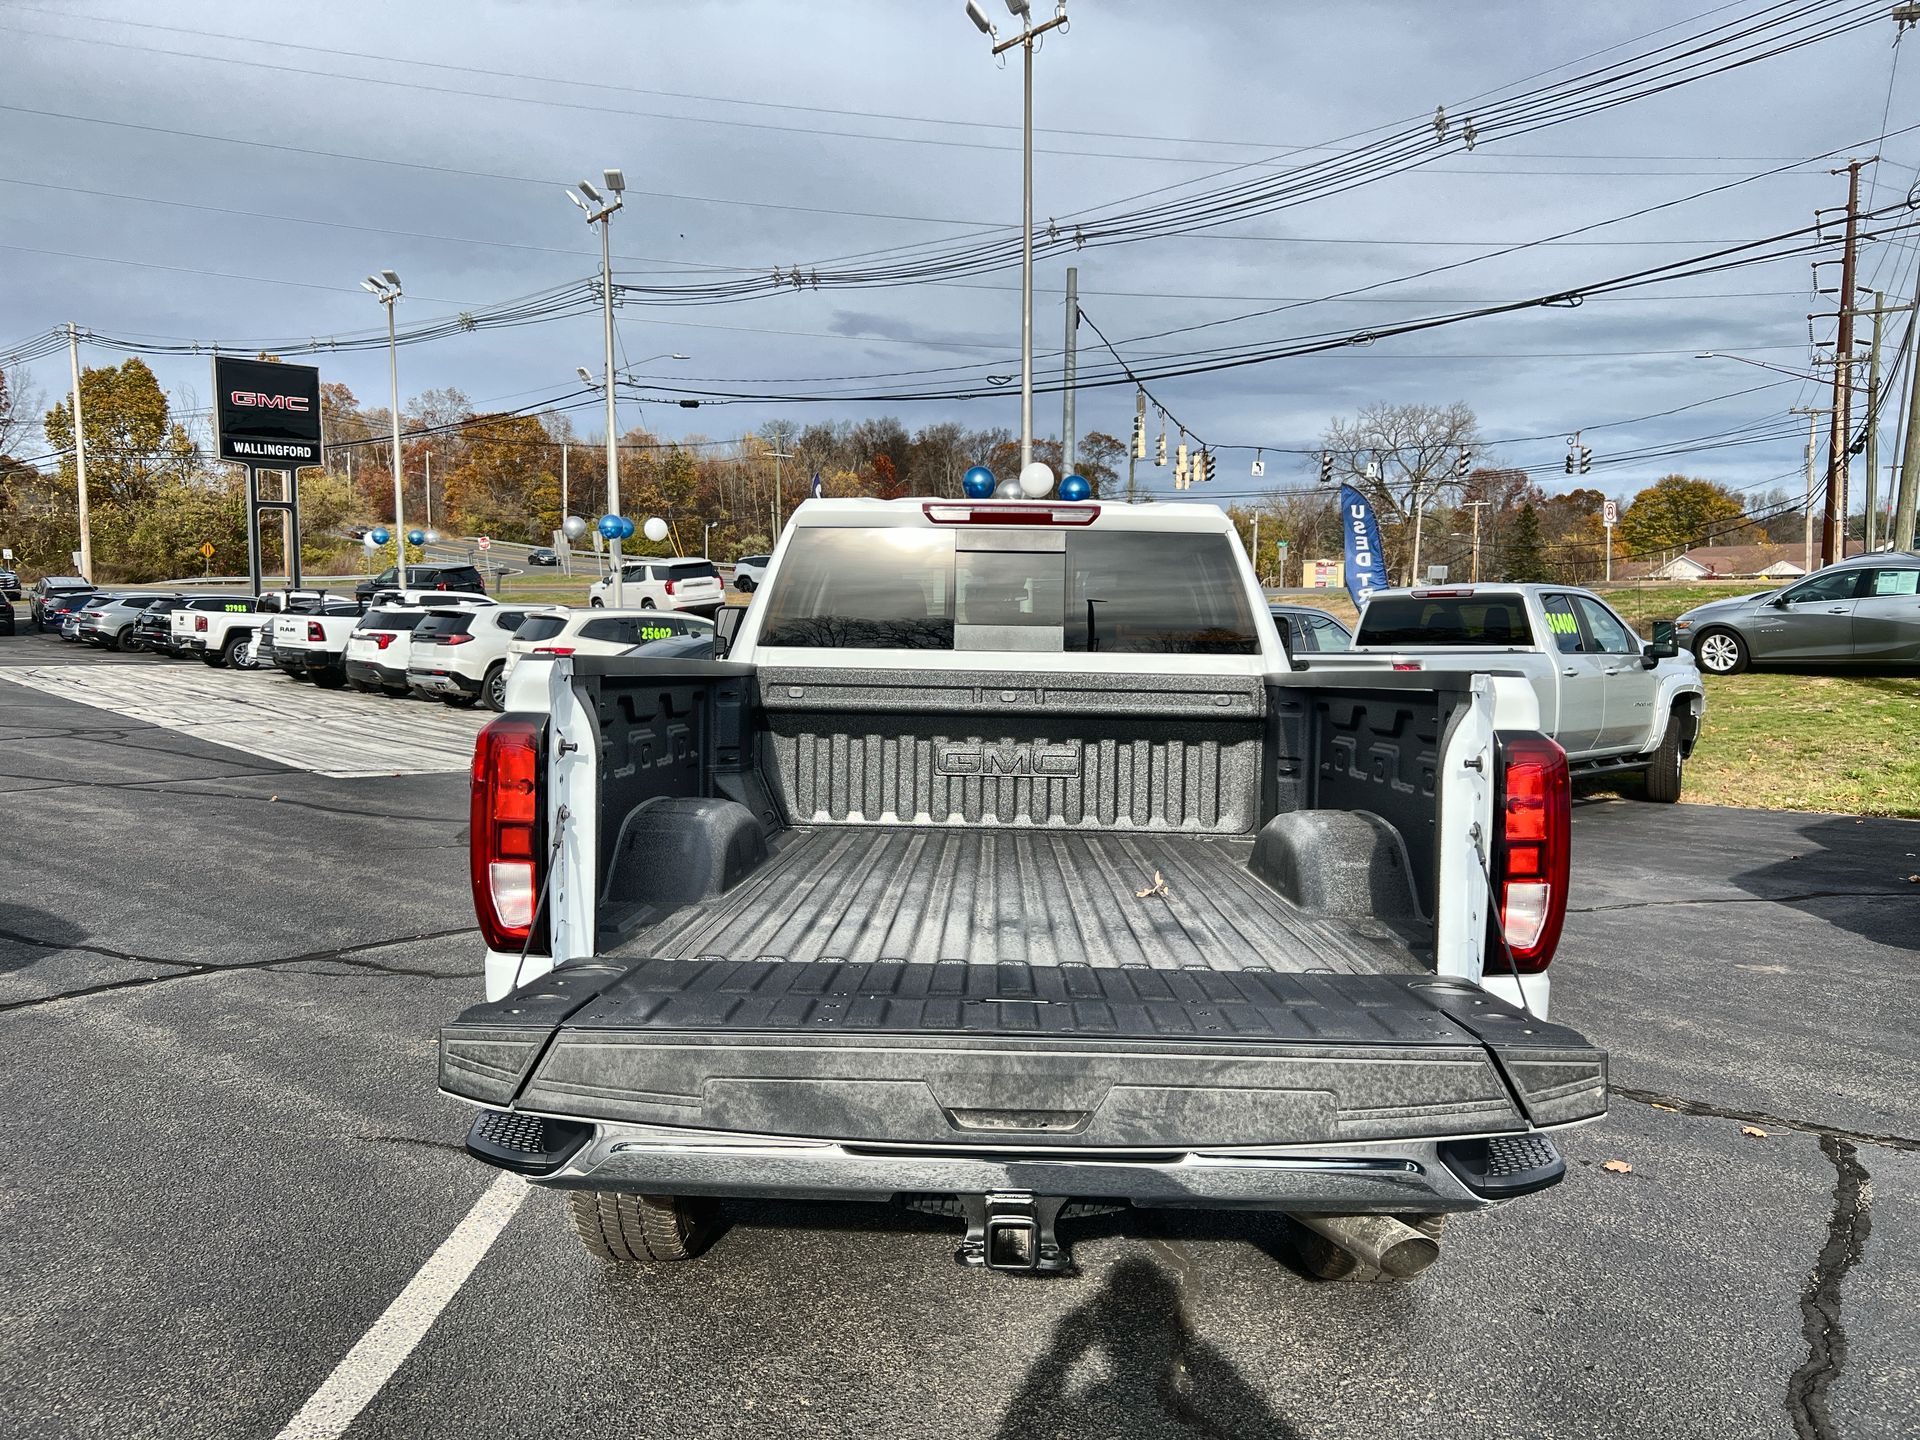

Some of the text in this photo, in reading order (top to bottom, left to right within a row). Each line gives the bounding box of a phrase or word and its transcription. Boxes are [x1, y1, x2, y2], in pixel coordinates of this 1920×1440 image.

[231, 391, 309, 411] GMC
[233, 442, 312, 458] WALLINGFORD
[641, 627, 672, 640] 25602
[937, 746, 1079, 775] GMC
